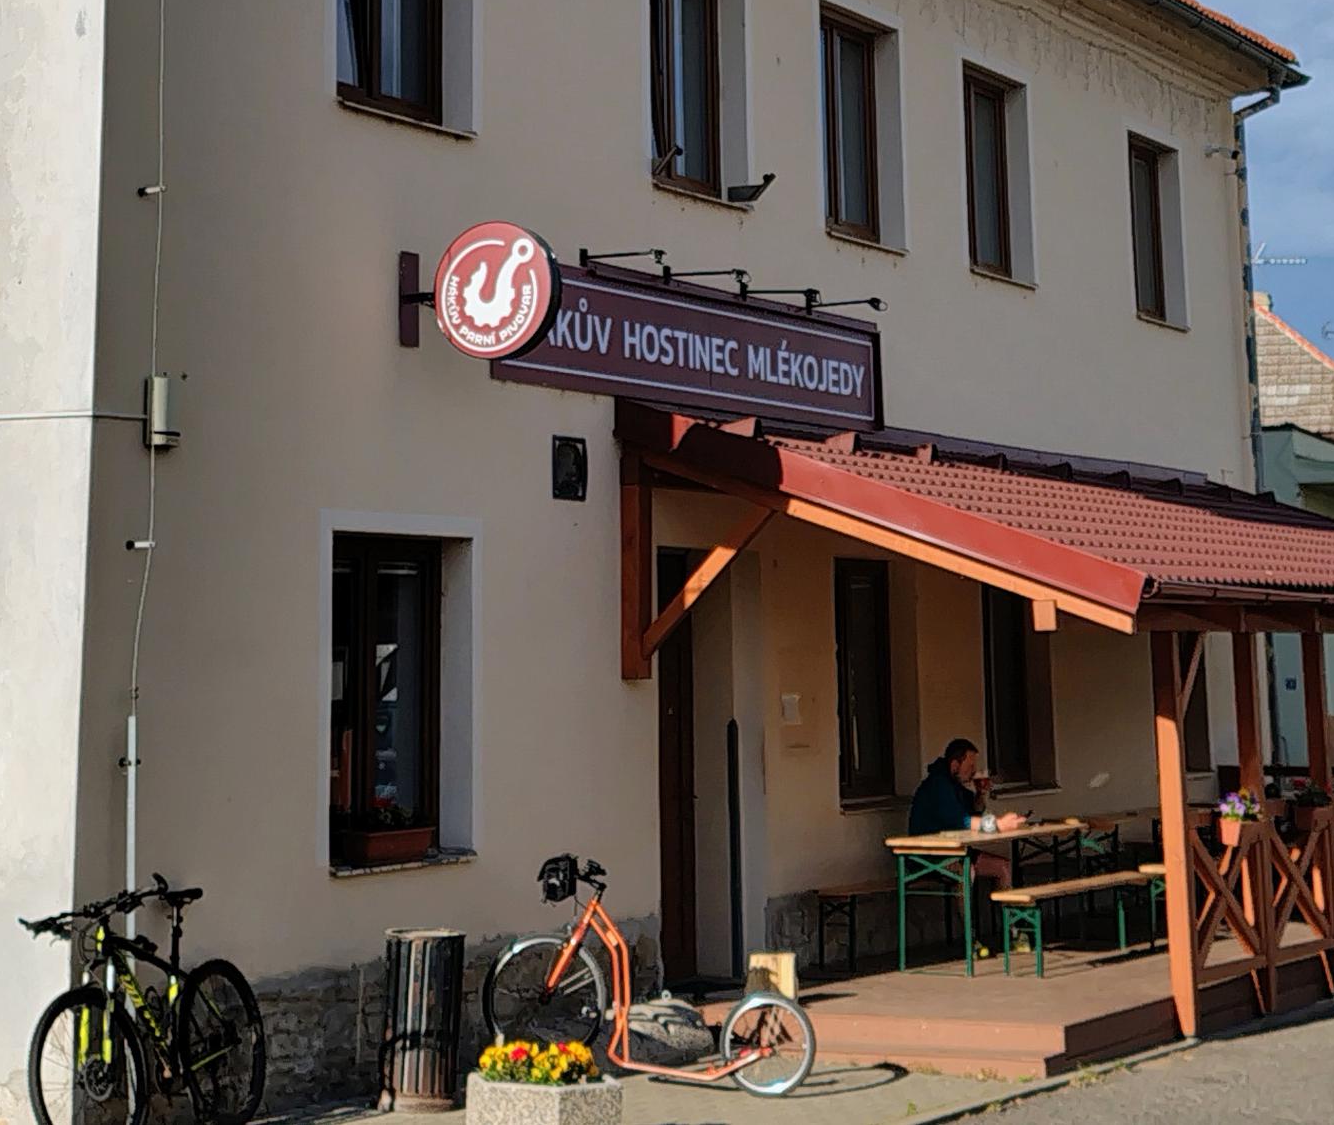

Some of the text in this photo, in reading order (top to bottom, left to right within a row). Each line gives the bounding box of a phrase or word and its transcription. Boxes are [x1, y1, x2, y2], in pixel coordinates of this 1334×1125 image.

[459, 325, 497, 346] PARNÍ
[499, 284, 532, 341] PIVOVAR
[623, 320, 739, 377] HOSTINEC
[747, 339, 865, 399] MLÉKOJEDY
